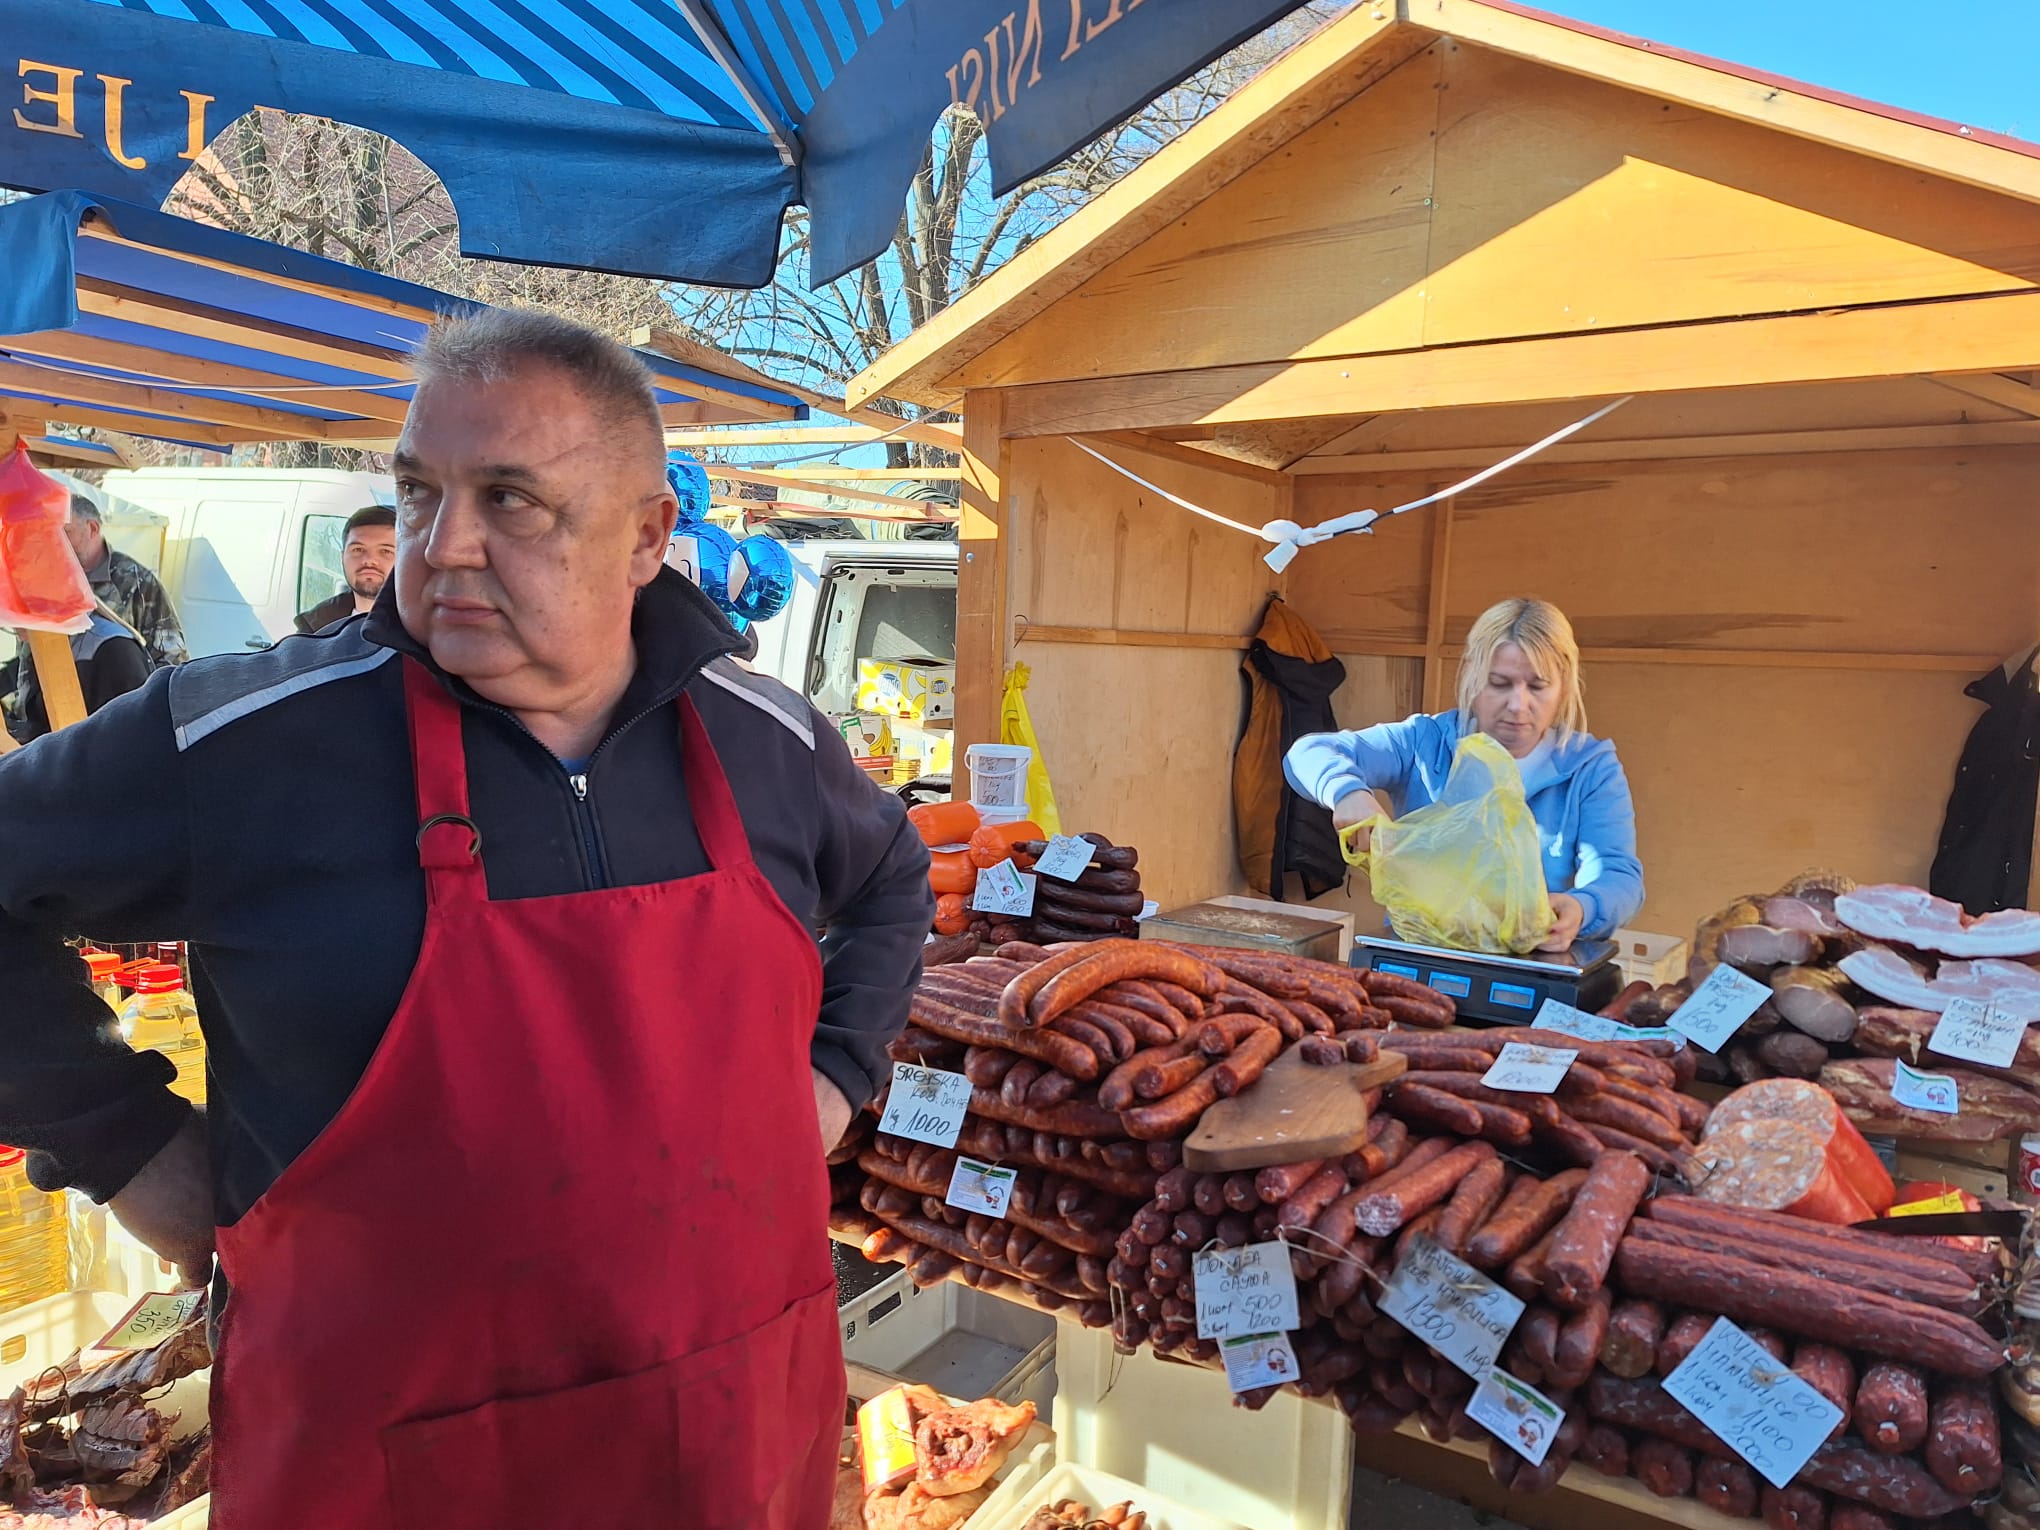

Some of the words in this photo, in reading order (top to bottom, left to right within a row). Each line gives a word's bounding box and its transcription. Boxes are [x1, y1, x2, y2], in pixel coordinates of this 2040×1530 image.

[1241, 1294, 1283, 1315] 500
[1247, 1311, 1281, 1330] 1200
[1404, 1294, 1456, 1341] 1300
[1723, 1425, 1774, 1469] 2000
